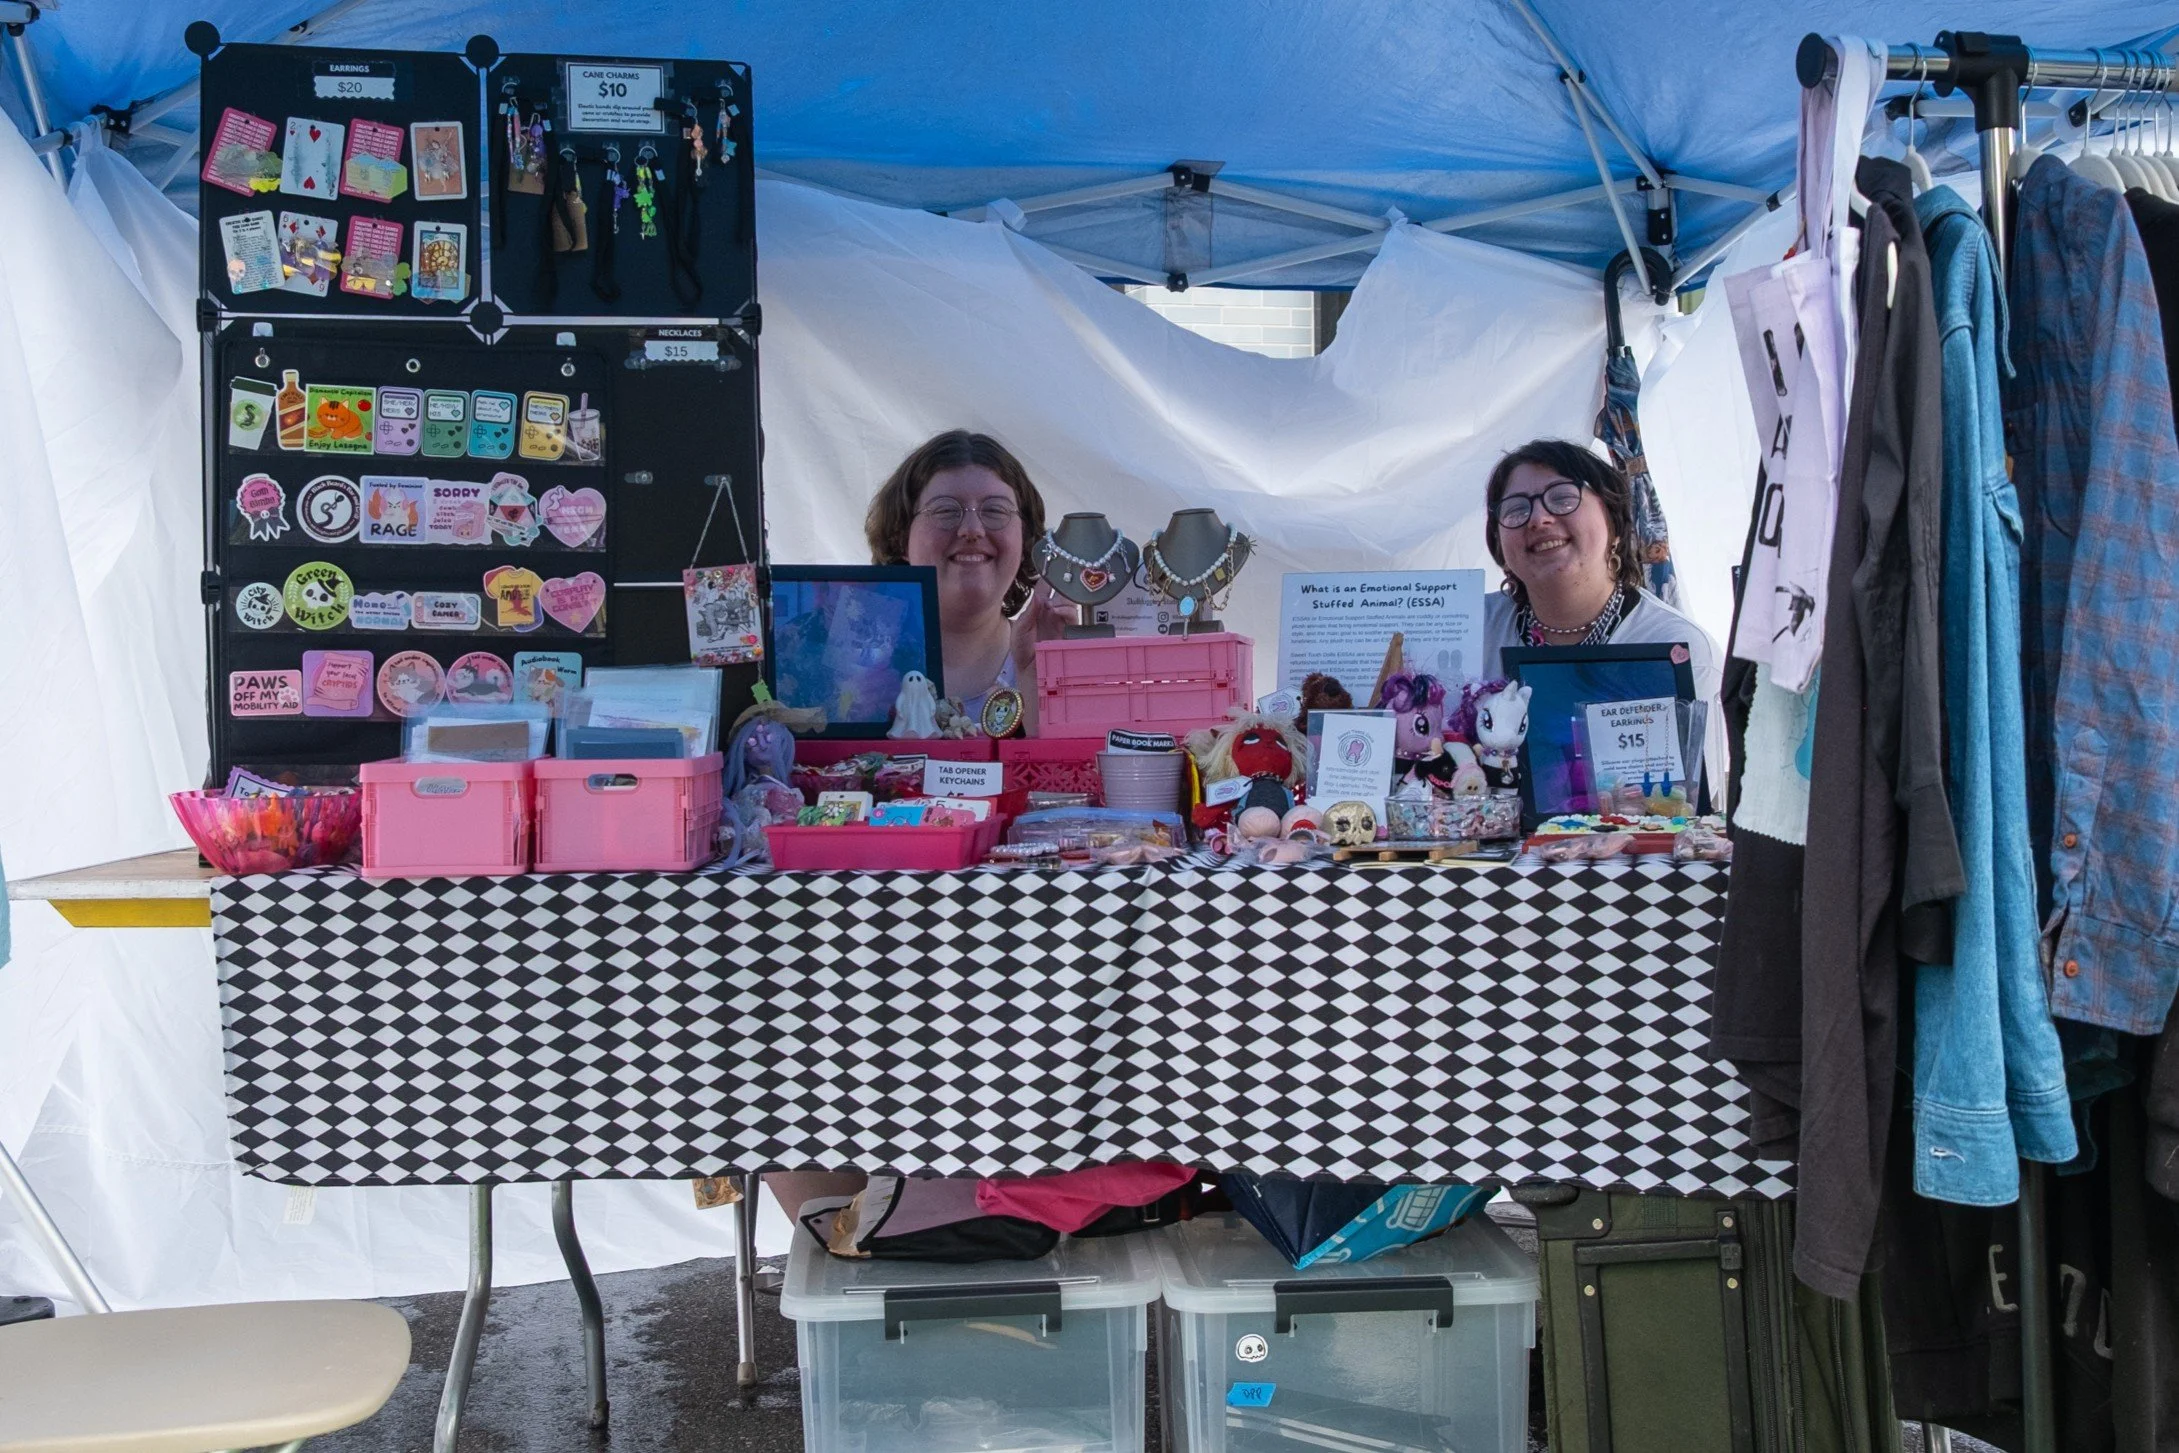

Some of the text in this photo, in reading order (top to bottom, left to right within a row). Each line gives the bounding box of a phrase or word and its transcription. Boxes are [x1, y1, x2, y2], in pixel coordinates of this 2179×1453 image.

[329, 64, 370, 72] EARRINGS
[606, 72, 640, 80] CHARMS
[338, 82, 362, 93] $20
[598, 80, 628, 98] $10
[290, 122, 296, 130] 2
[284, 214, 288, 222] 6
[664, 344, 688, 357] $15
[309, 442, 368, 450] Enjoy Lasagna
[434, 488, 480, 498] SORRY
[370, 523, 417, 537] RAGE
[296, 568, 337, 585] Green
[248, 586, 267, 597] City
[550, 585, 594, 597] COSPLAY
[1301, 584, 1329, 594] What
[1333, 585, 1340, 593] is
[1360, 583, 1412, 593] Emotional
[1415, 582, 1457, 594] Support
[1312, 597, 1445, 609] Stuffed Animal? (ESSA)
[244, 612, 274, 625] Witch
[296, 604, 346, 624] Witch
[520, 656, 560, 666] Audiobook
[557, 666, 577, 674] Worm
[234, 676, 288, 690] PAWS
[234, 690, 279, 701] OFF MY
[234, 702, 279, 710] MOBILITY
[1601, 704, 1662, 717] EAR DEFENDER
[1610, 718, 1654, 727] EARRINGS
[1112, 734, 1130, 745] PAPER
[1132, 739, 1152, 747] BOOK
[1618, 733, 1645, 749] $15
[939, 766, 986, 775] TAB OPENER
